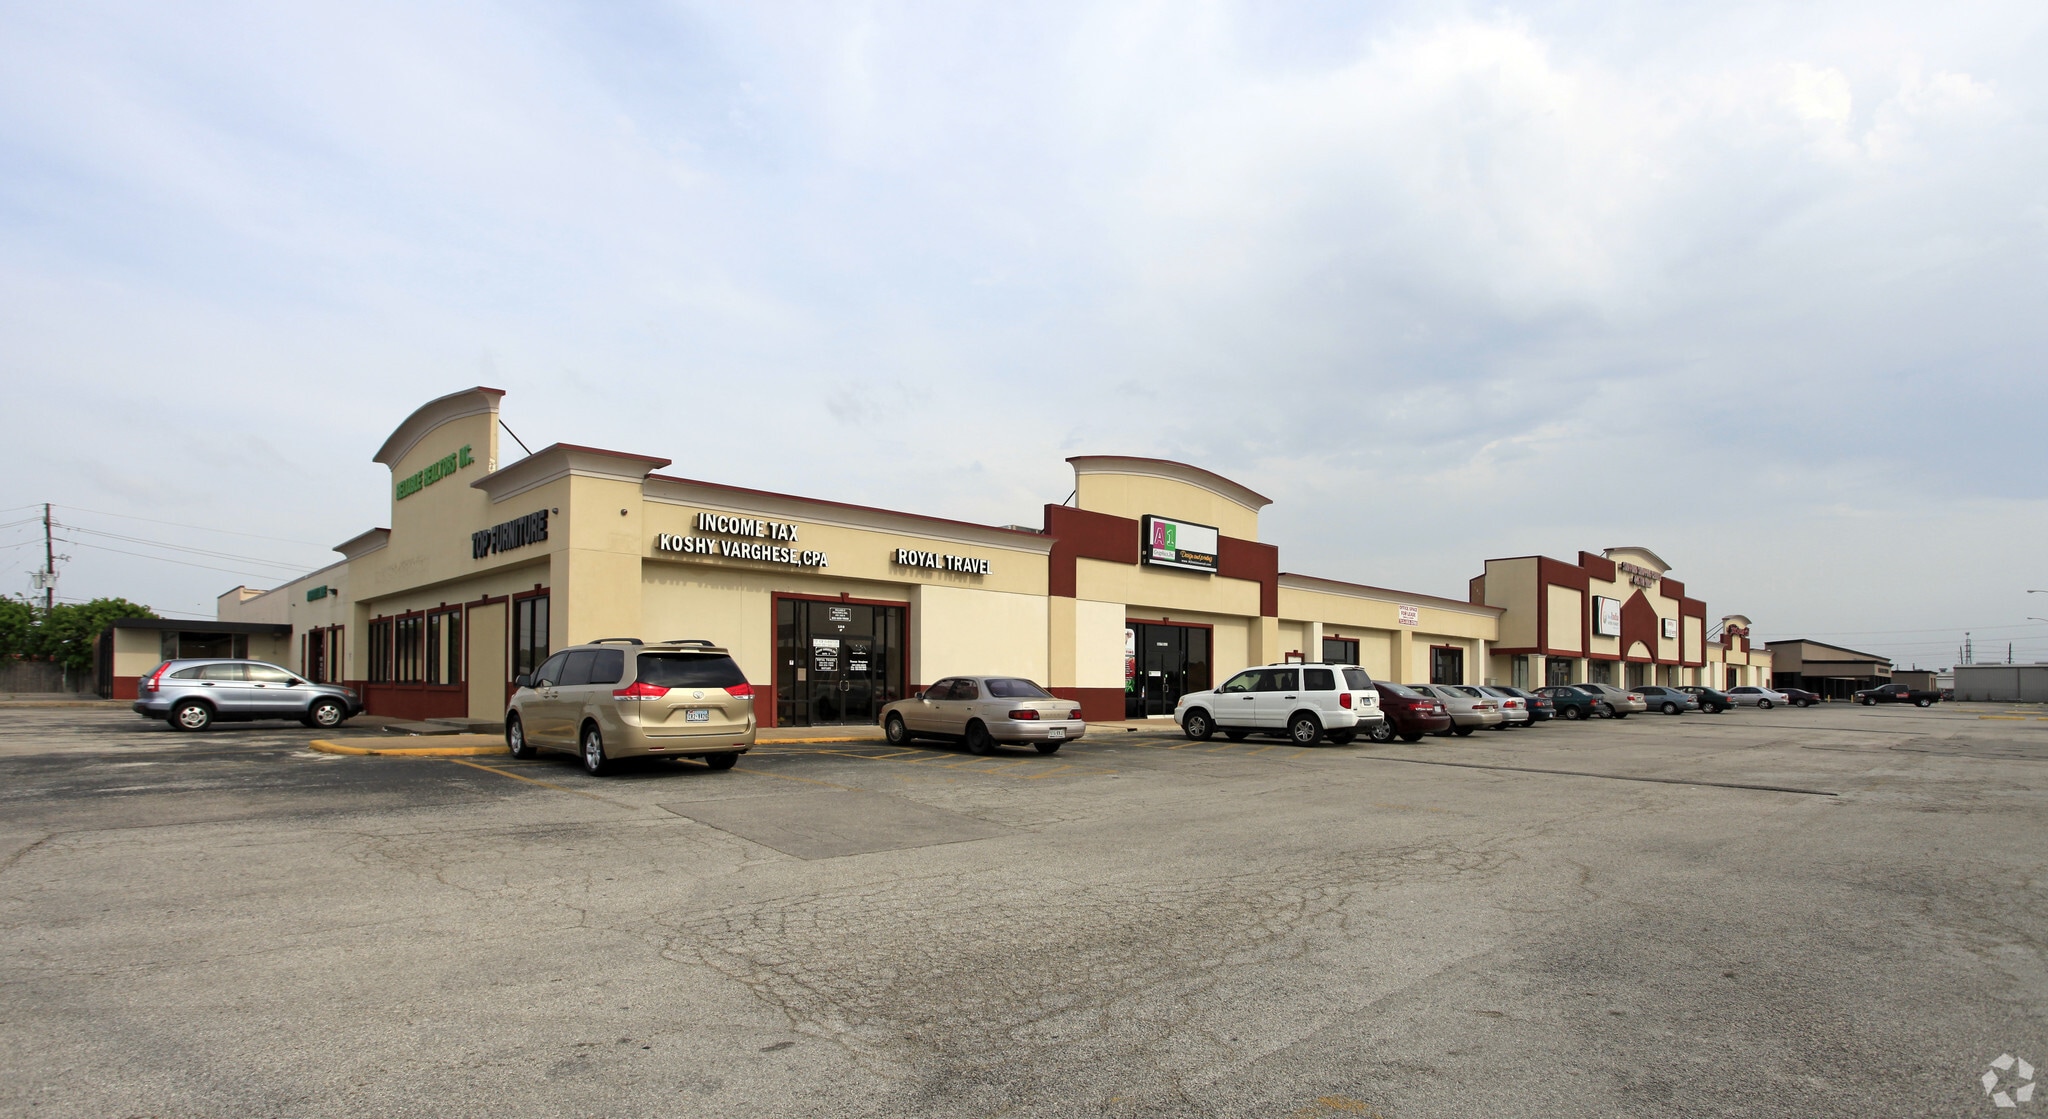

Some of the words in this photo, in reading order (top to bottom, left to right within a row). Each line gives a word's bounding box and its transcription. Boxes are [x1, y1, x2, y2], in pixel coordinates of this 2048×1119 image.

[472, 529, 491, 560] TOP
[491, 509, 549, 555] FURNITURE
[698, 512, 765, 538] INCOME
[768, 522, 799, 542] TAX
[659, 533, 716, 555] KOSHY
[720, 540, 802, 568] VARGHESE,
[803, 550, 829, 567] CPA
[896, 548, 942, 569] ROYAL
[944, 554, 993, 575] TRAVEL
